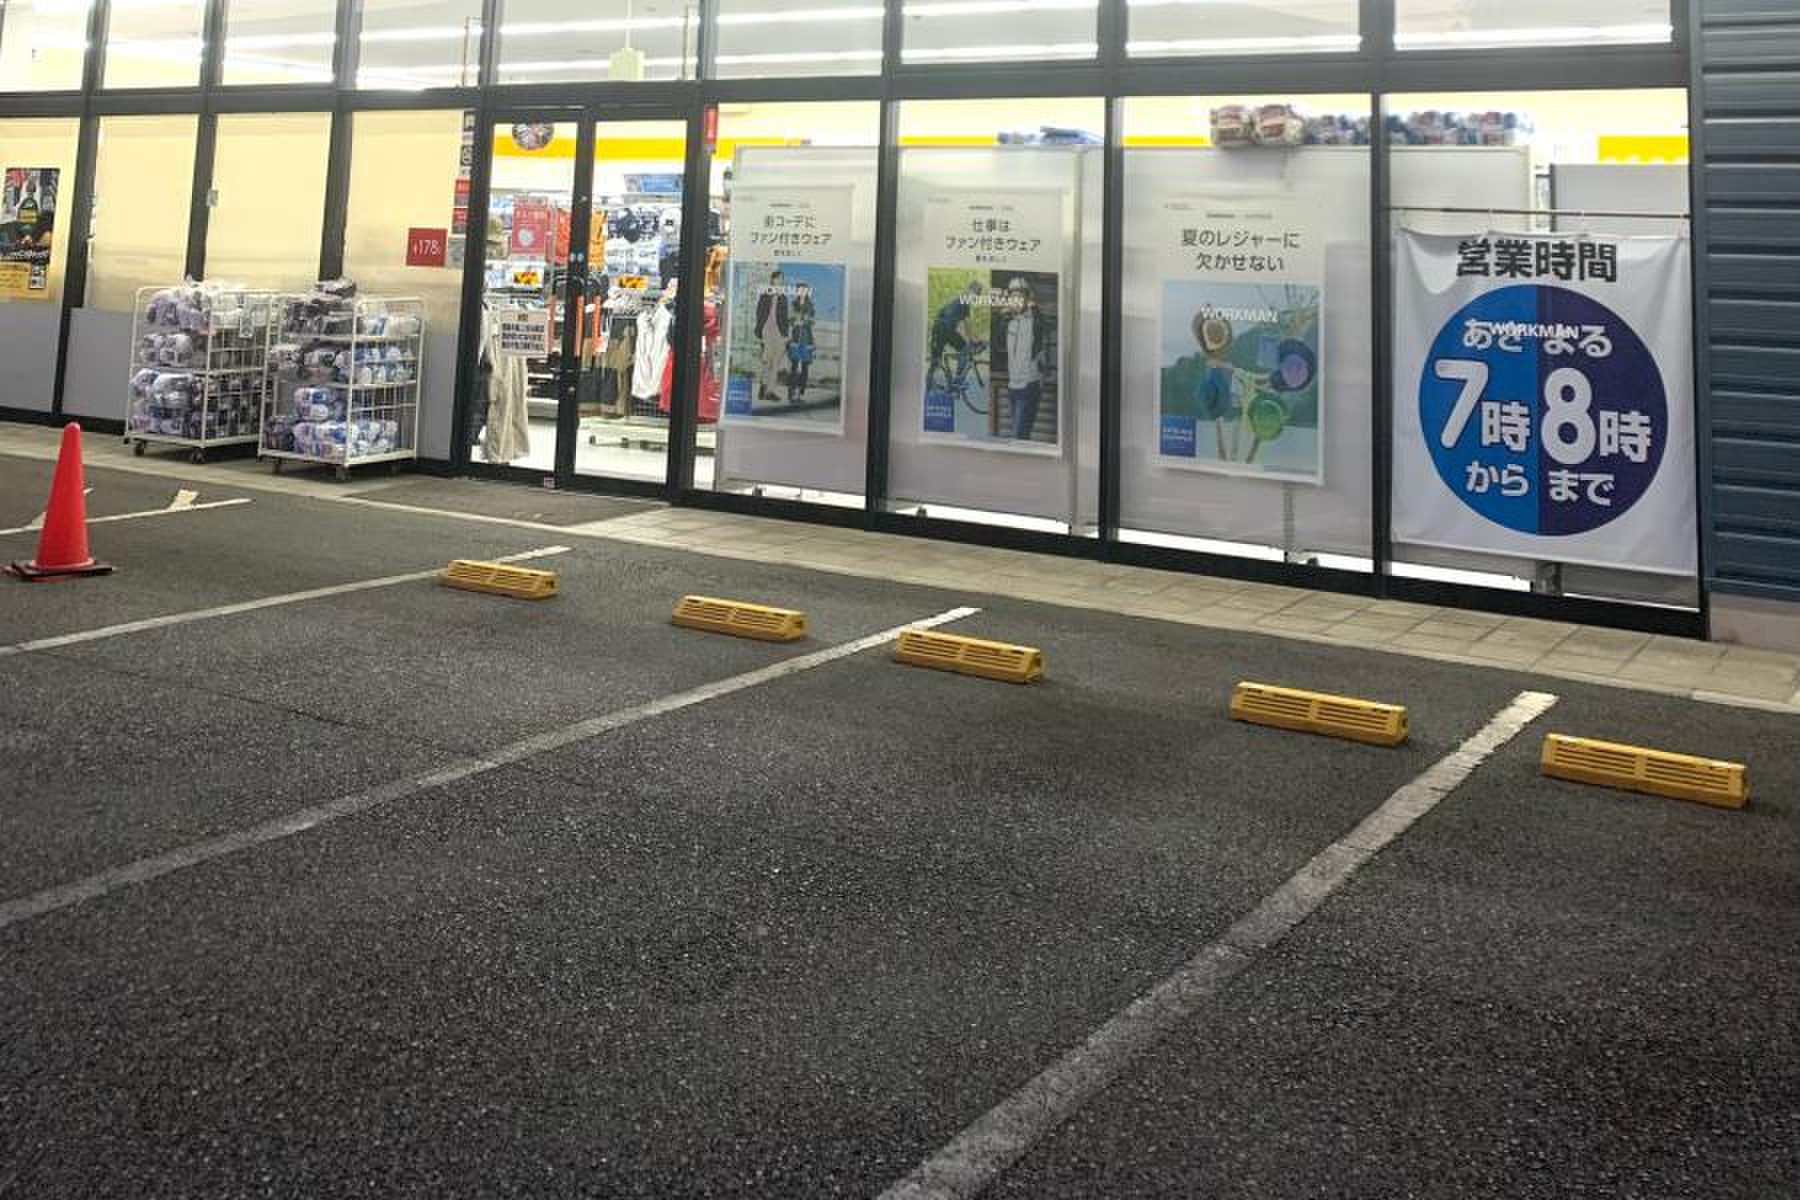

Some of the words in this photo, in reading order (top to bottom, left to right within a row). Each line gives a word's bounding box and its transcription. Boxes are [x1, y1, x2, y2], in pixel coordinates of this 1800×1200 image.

[944, 235, 1042, 252] ファン付きウェア
[1181, 228, 1301, 249] 夏のレジャーに
[1195, 251, 1285, 272] 欠かせない
[1456, 238, 1618, 283] 営業時間
[1489, 321, 1579, 339] WORKMAN
[1465, 459, 1531, 498] から
[1548, 469, 1617, 507] まで
